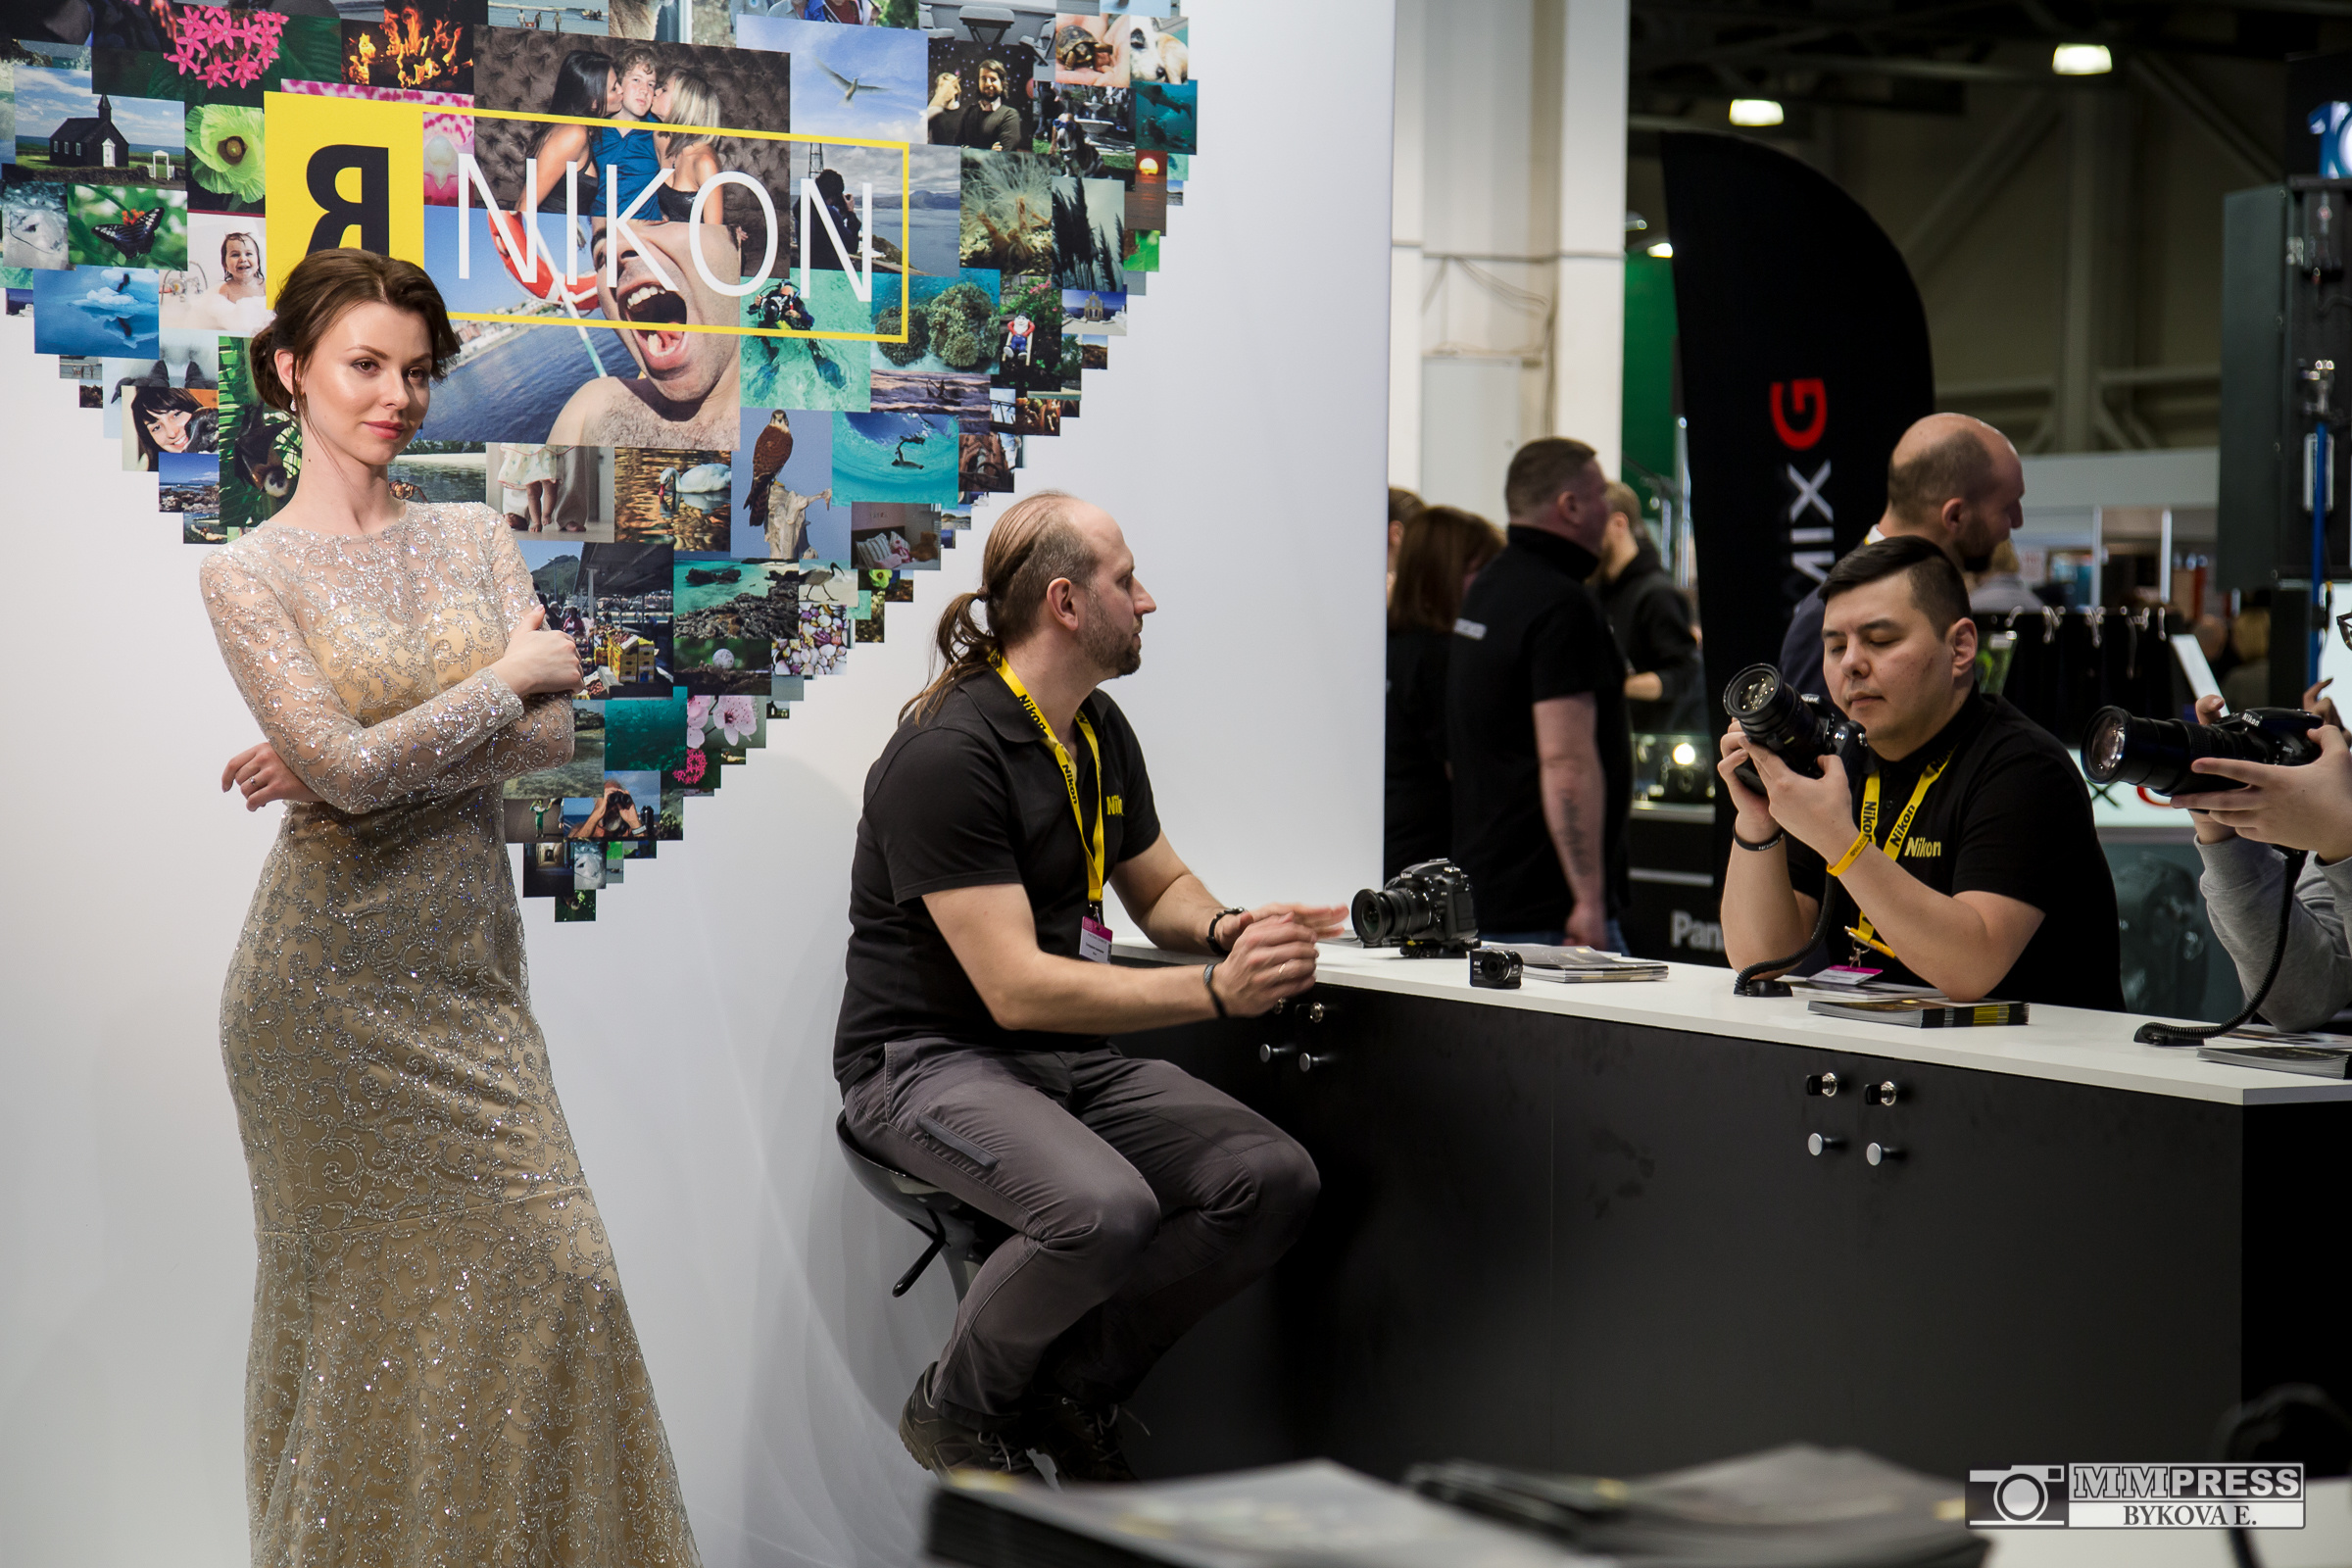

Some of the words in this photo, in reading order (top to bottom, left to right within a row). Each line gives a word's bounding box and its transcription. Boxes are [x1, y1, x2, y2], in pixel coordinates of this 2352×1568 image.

[457, 153, 873, 302] NIKON
[1771, 378, 1828, 450] G
[2242, 712, 2260, 726] Nikon
[1062, 764, 1077, 804] Nikon
[1889, 805, 1915, 848] Nikon
[1904, 837, 1941, 858] Nikon
